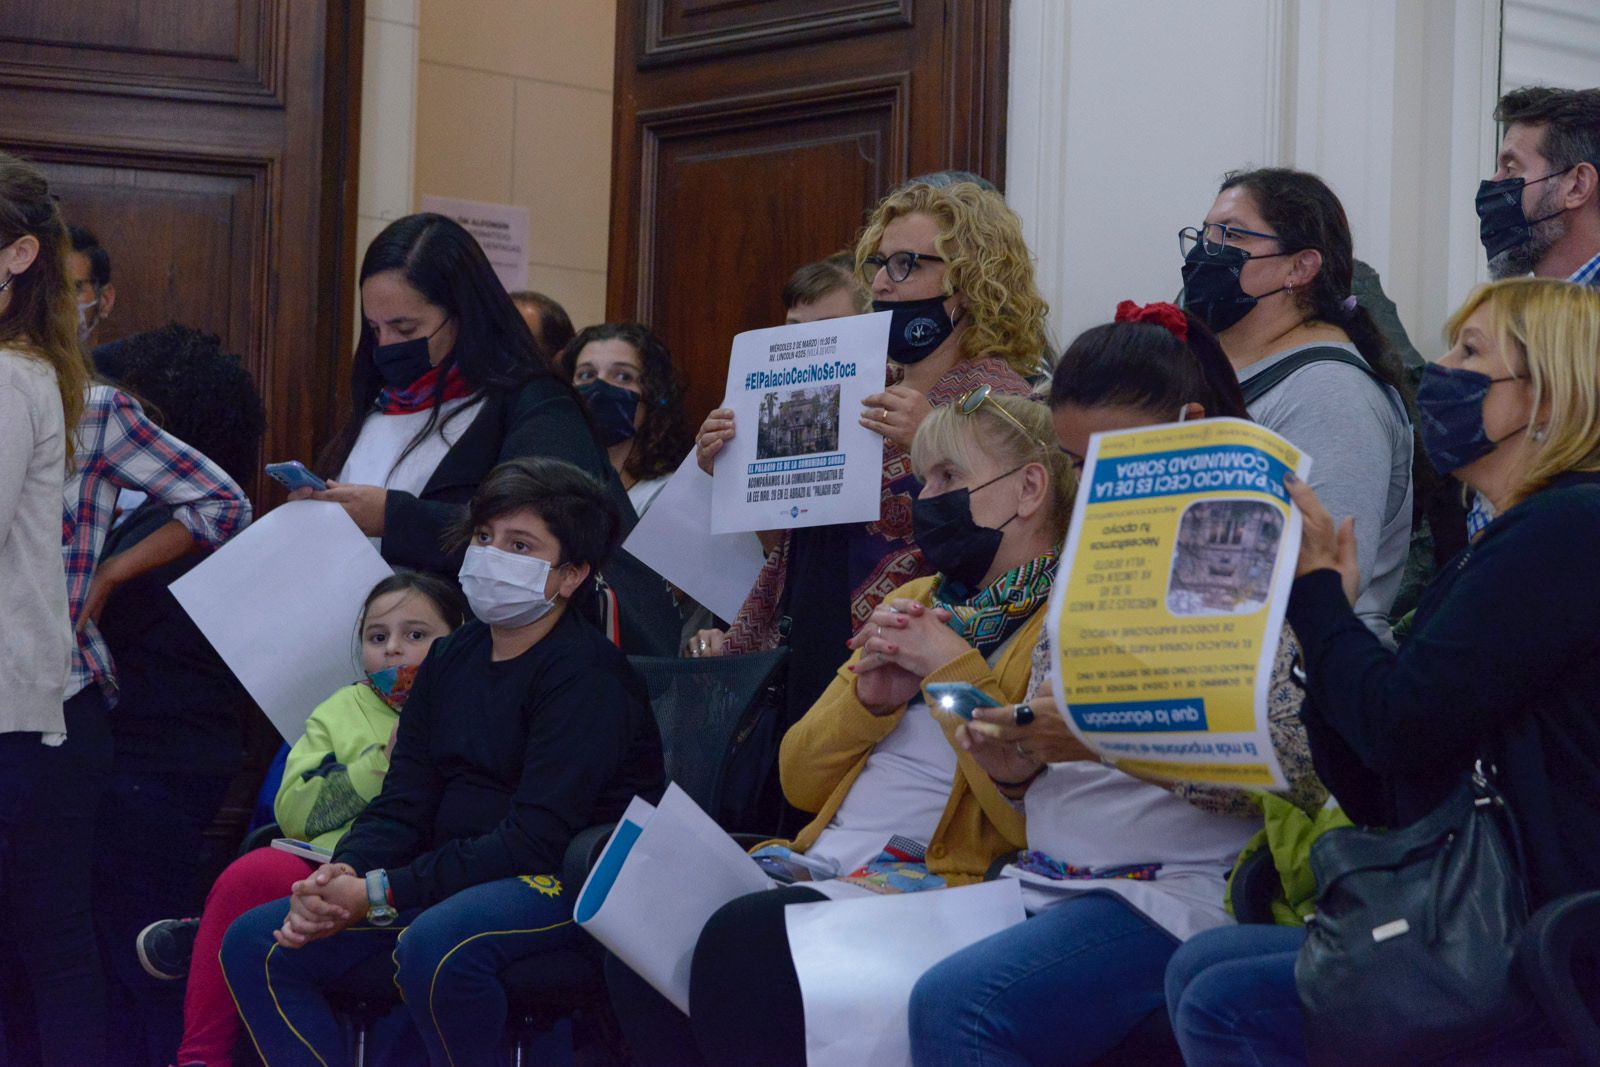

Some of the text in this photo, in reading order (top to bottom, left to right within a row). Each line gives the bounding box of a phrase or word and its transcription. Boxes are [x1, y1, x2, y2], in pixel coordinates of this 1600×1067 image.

[745, 362, 856, 391] #ElPalacioCeciNoSeToca
[1117, 451, 1269, 479] COMUNIDAD SORDA
[1116, 480, 1136, 495] DE
[1137, 477, 1153, 493] ES
[1155, 475, 1192, 492] CECI
[1194, 470, 1267, 489] PALACIO
[1095, 482, 1113, 497] LA
[1102, 522, 1138, 535] apoyo
[1090, 536, 1160, 550] Necesitamos
[1082, 705, 1199, 728] que la educación
